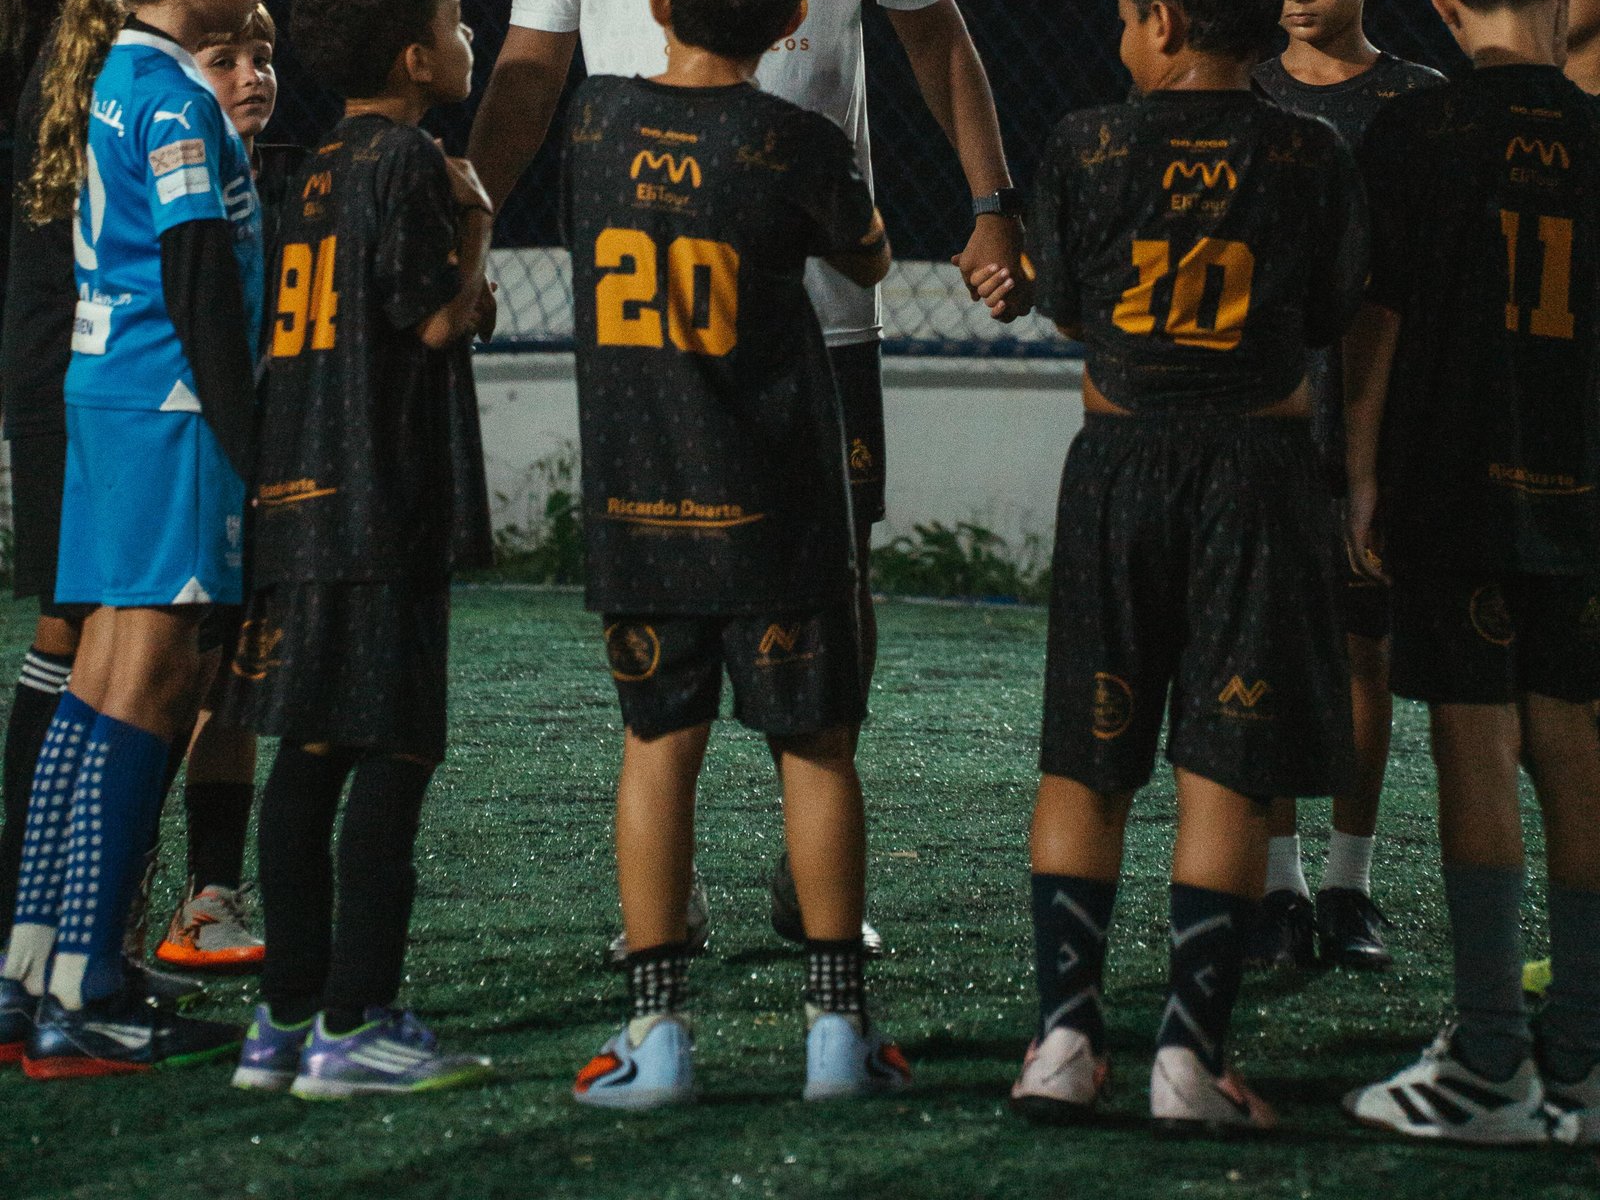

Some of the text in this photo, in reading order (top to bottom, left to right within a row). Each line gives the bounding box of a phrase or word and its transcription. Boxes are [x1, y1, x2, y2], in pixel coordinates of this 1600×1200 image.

[271, 234, 339, 358] 94
[595, 227, 740, 357] 20
[1111, 233, 1256, 351] 10
[1500, 207, 1575, 339] 11
